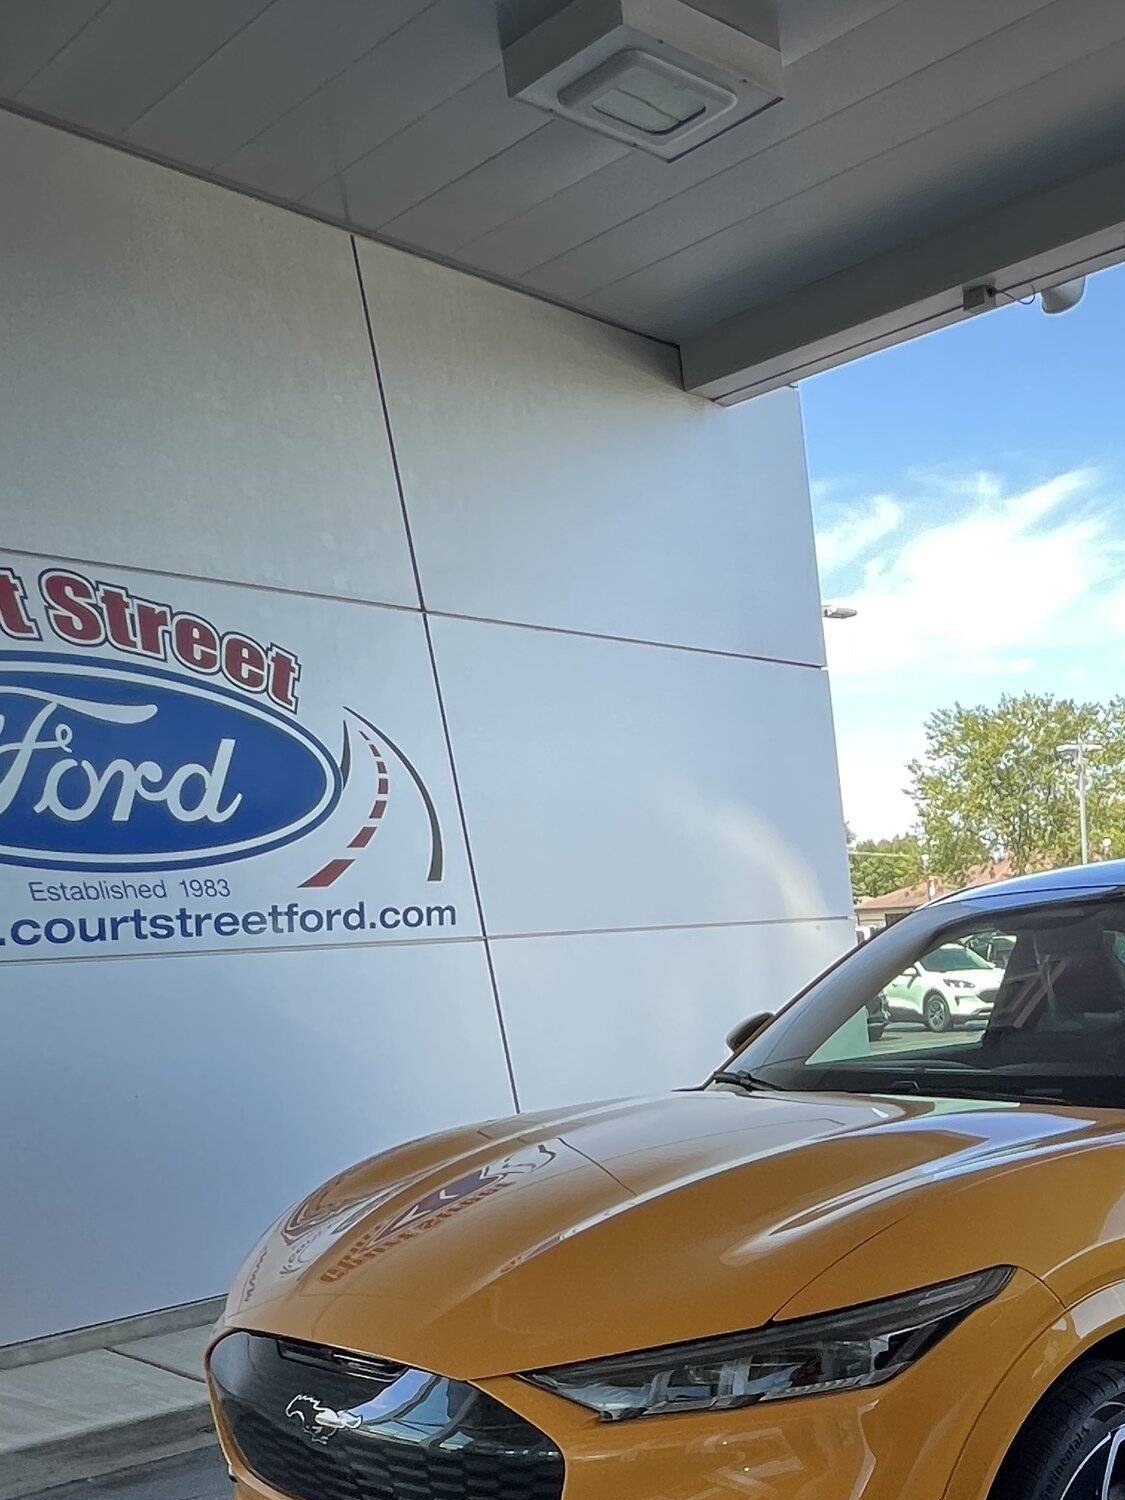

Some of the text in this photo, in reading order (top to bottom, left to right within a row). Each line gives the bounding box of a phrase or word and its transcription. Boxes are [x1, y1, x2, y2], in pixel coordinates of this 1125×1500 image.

[38, 567, 302, 713] Street
[0, 686, 243, 823] Ford
[28, 878, 231, 902] Established 1983
